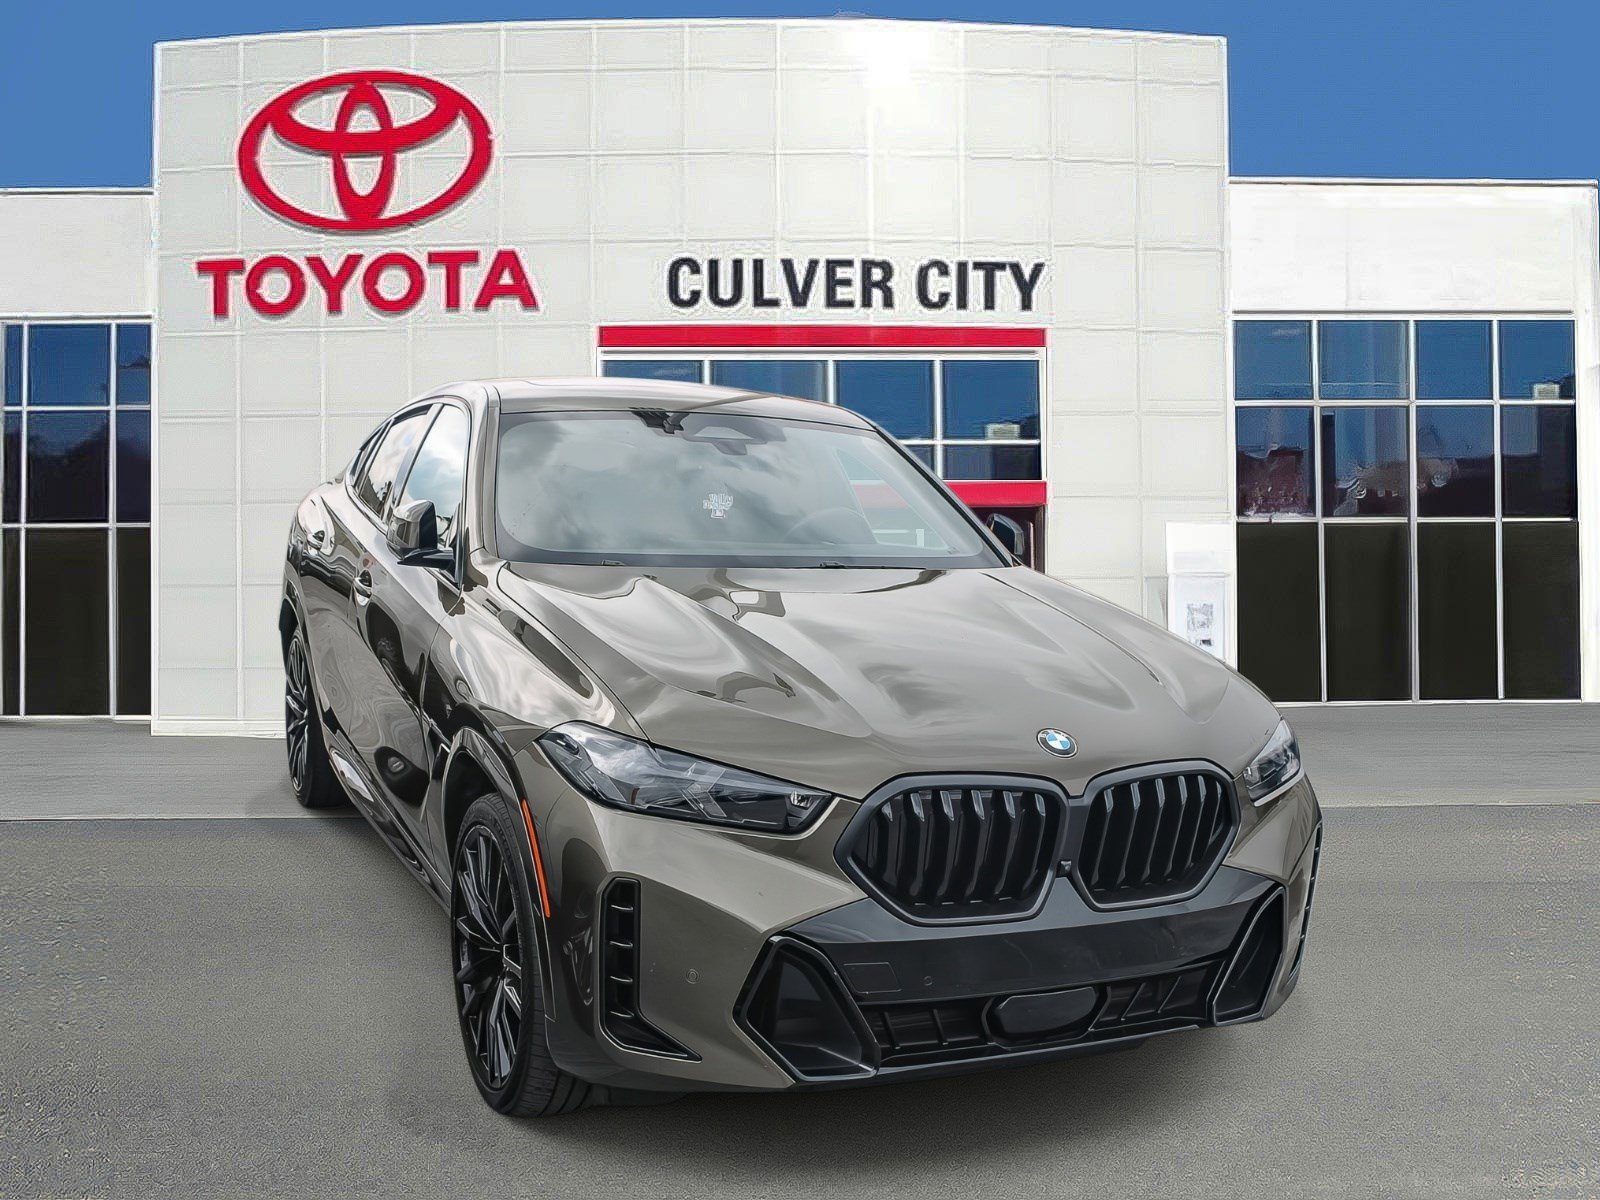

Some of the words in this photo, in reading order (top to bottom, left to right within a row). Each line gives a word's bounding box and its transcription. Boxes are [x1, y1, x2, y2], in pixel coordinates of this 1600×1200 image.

[195, 249, 539, 318] TOYOTA
[668, 257, 895, 309] CULVER
[916, 259, 1046, 311] CITY
